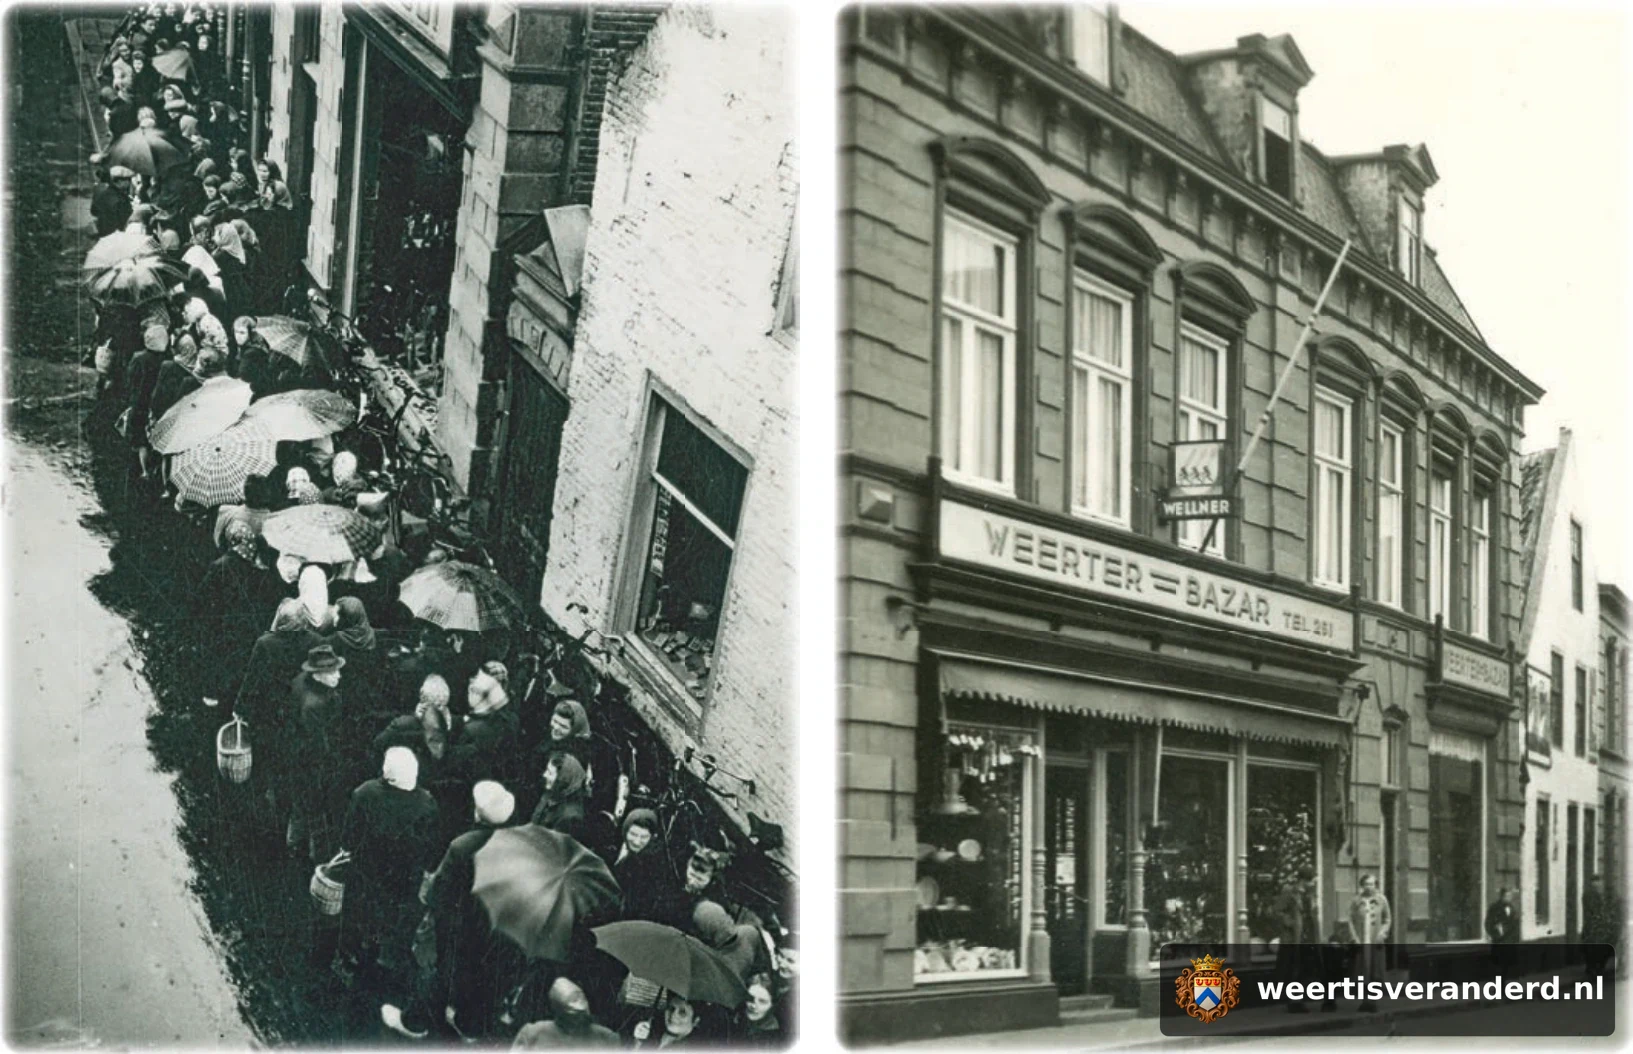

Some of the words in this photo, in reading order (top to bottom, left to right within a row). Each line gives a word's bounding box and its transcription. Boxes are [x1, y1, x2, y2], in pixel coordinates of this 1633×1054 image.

[1163, 500, 1230, 516] WELLNER
[984, 519, 1142, 593] WEERTER
[1186, 575, 1271, 626] BAZAR
